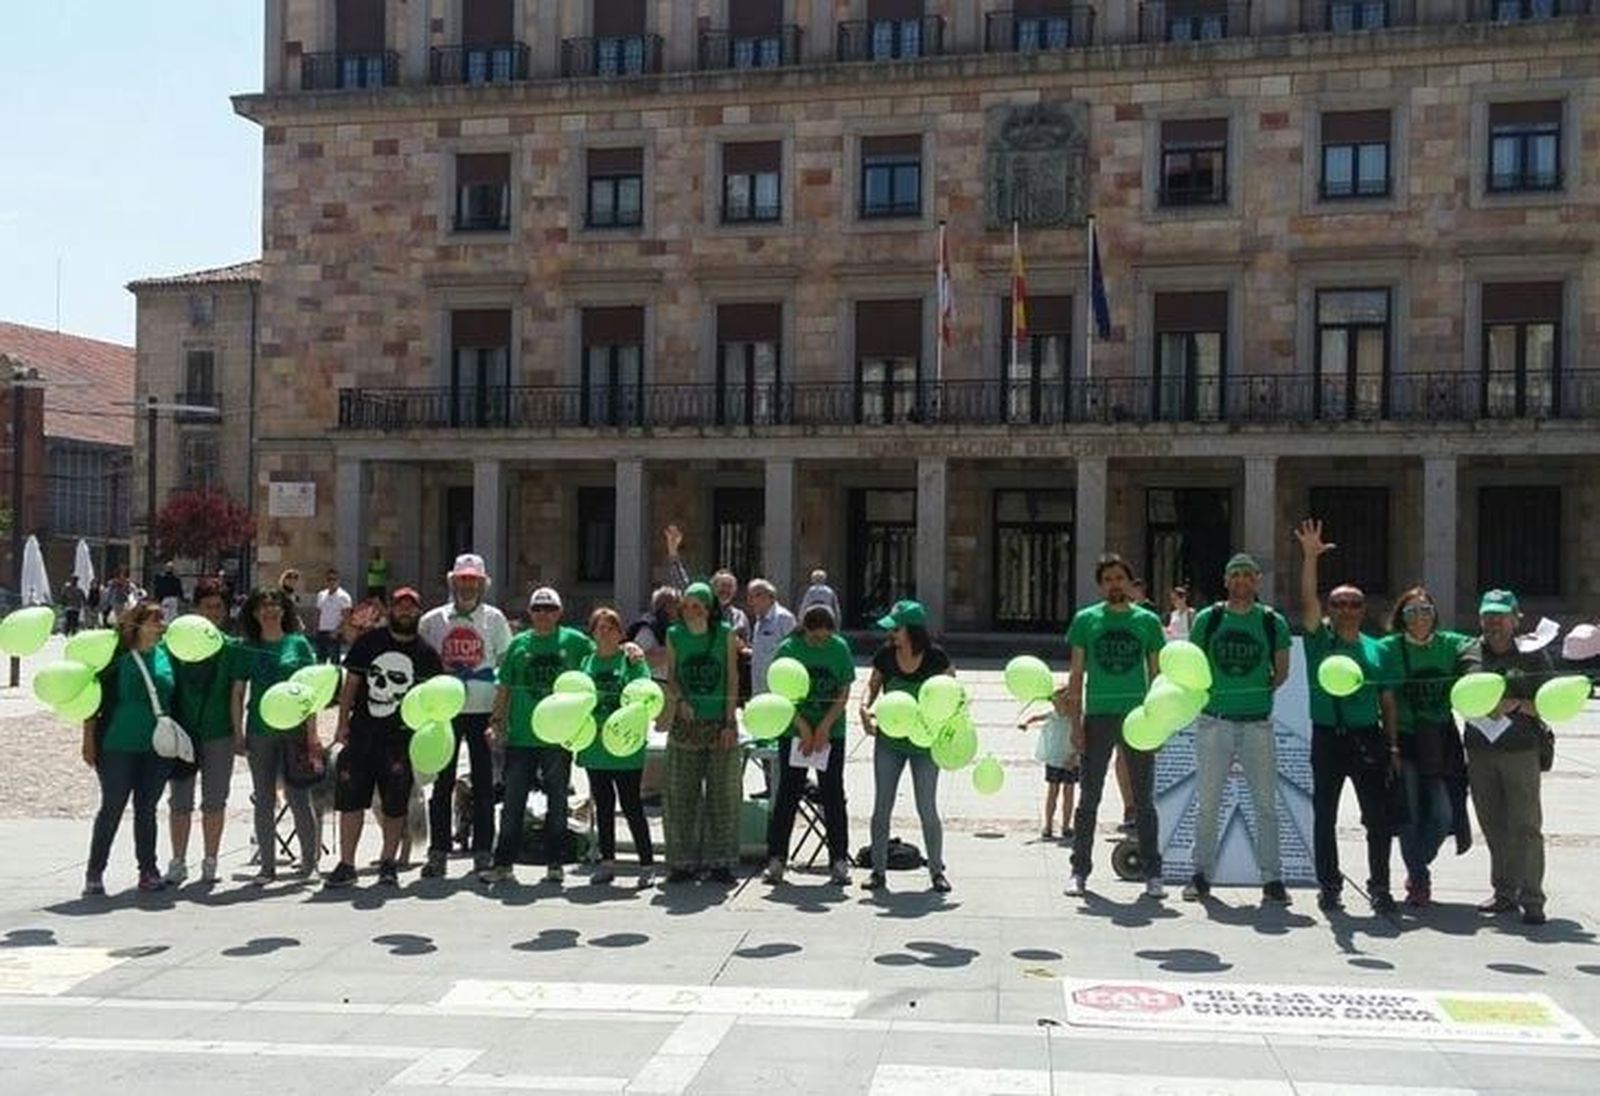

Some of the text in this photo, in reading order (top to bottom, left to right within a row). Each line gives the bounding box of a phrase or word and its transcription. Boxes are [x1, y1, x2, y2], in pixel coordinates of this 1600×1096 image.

[444, 639, 482, 654] STOP
[1096, 640, 1138, 655] STOP
[1215, 642, 1259, 657] STOP
